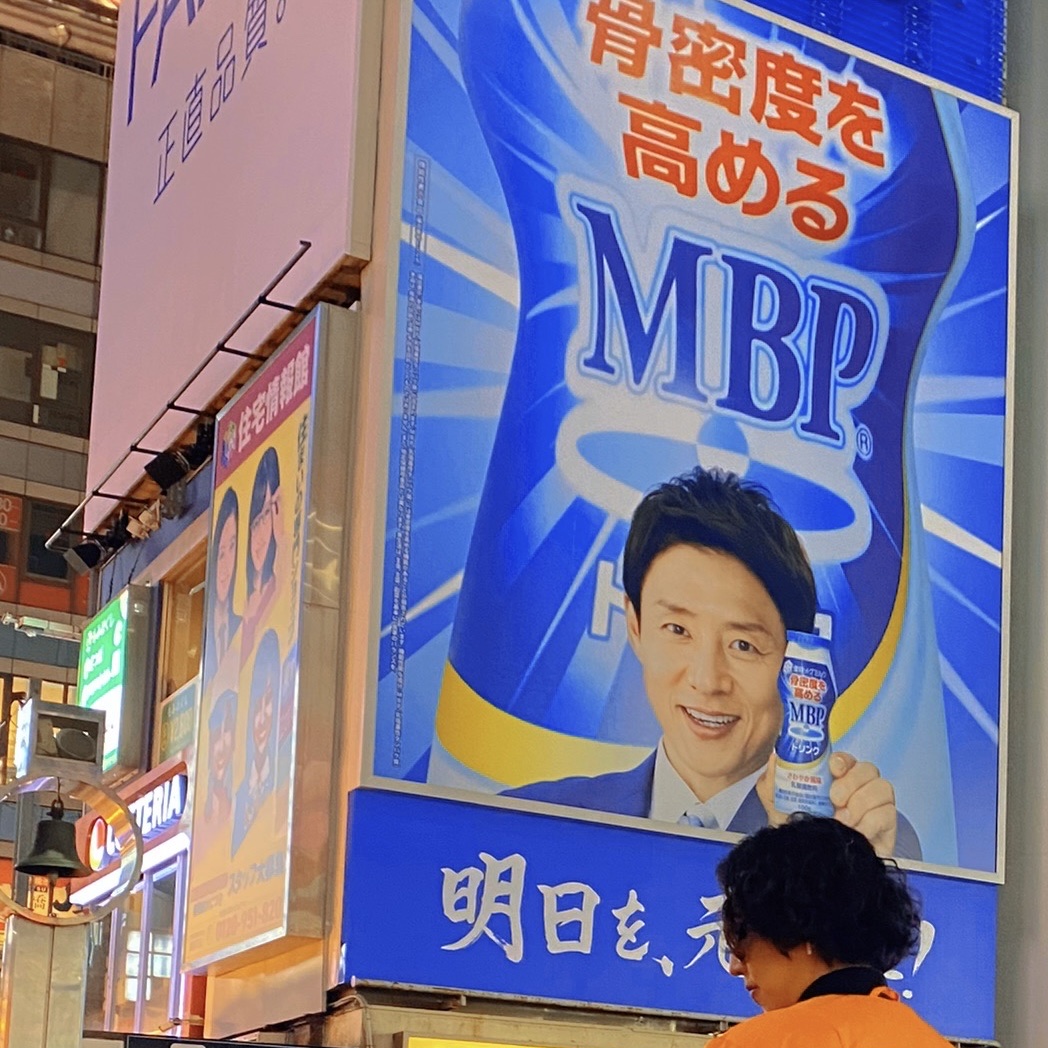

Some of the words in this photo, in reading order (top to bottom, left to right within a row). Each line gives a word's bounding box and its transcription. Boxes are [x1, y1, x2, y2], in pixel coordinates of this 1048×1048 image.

[586, 0, 886, 168] 骨密度を
[617, 94, 849, 242] 高める
[577, 203, 875, 442] MBP
[790, 702, 825, 726] MBP
[106, 774, 181, 857] LTERIA
